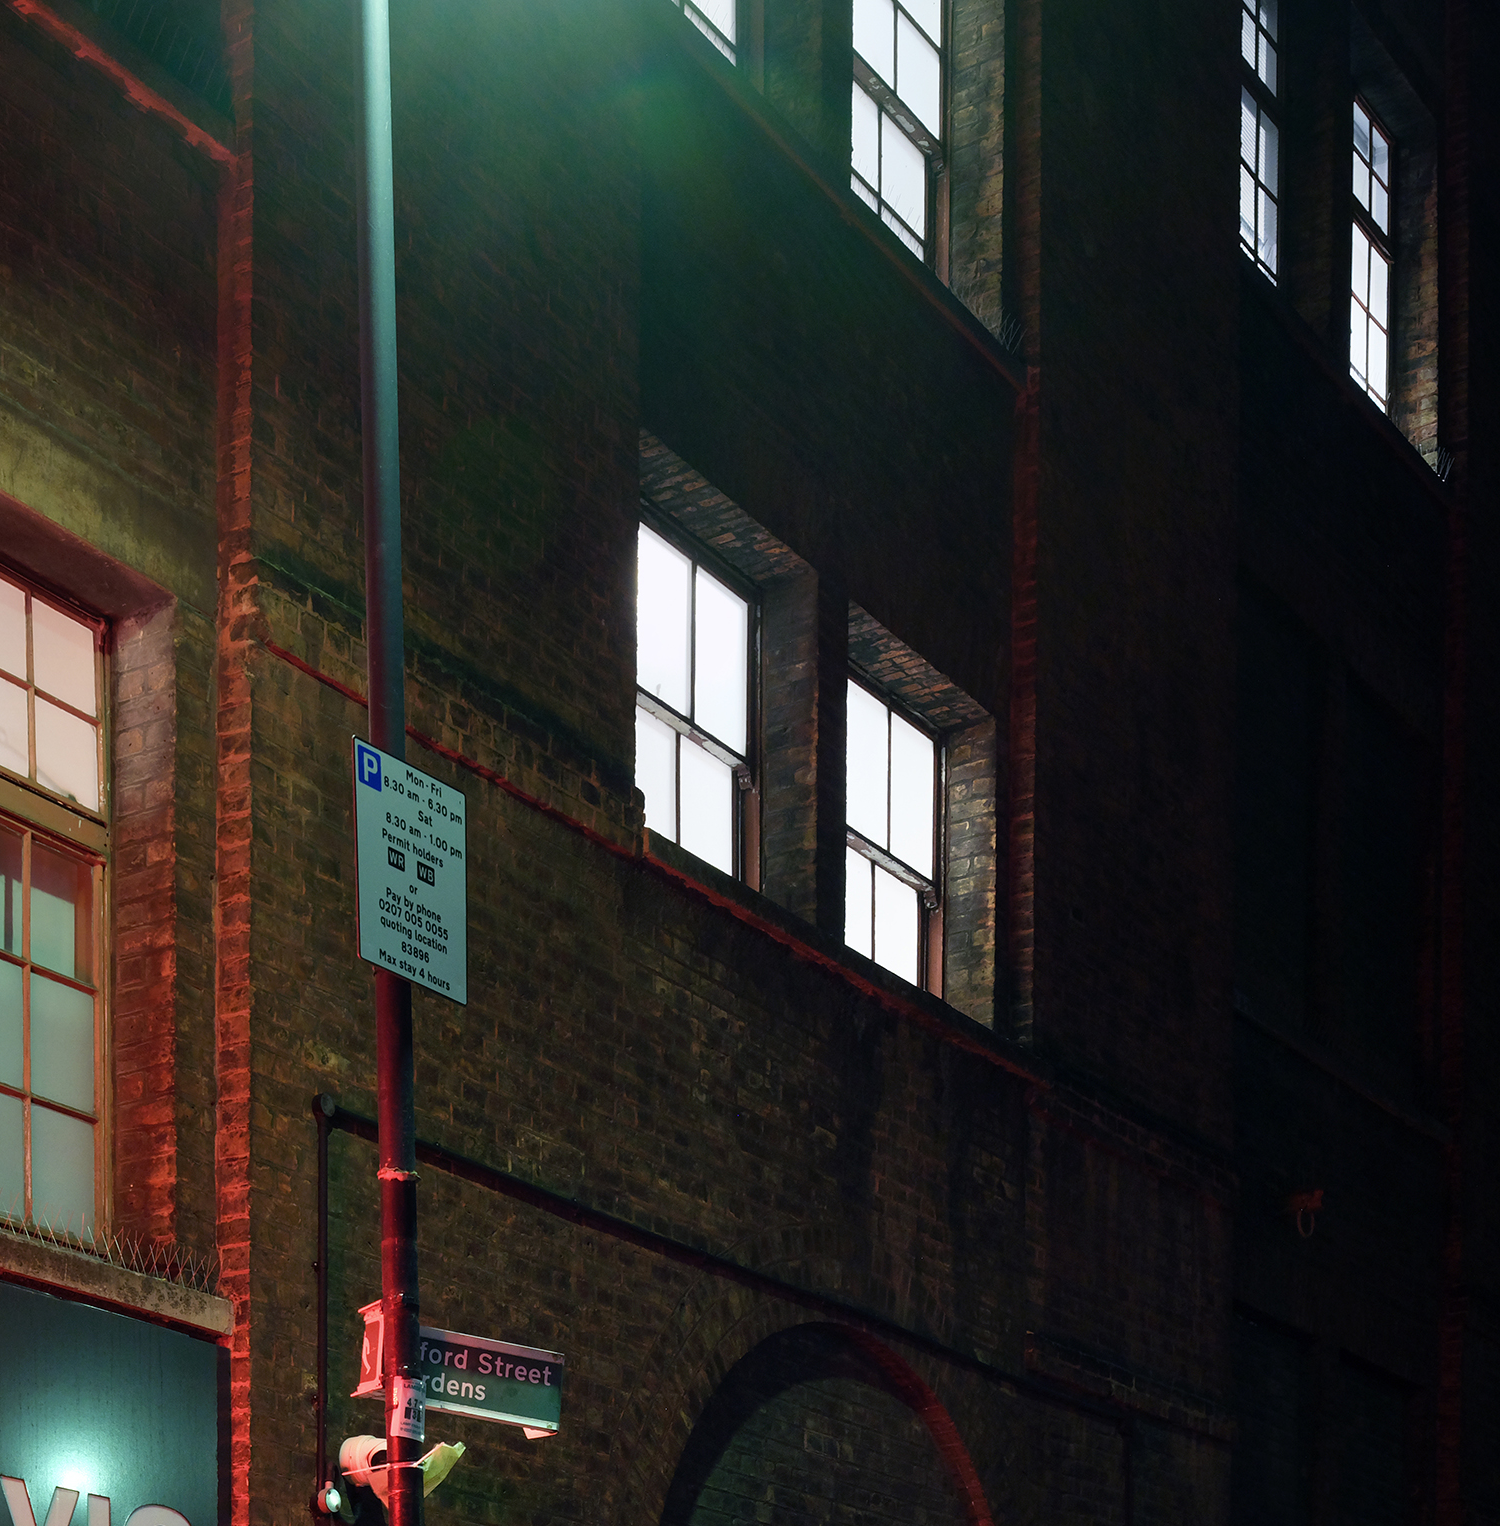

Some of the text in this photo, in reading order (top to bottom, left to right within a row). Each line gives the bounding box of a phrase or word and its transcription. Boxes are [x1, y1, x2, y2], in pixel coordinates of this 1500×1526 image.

[363, 751, 378, 782] P
[383, 775, 405, 795] 8.30
[407, 789, 420, 803] am
[427, 798, 448, 817] 6.30
[450, 812, 463, 825] pm
[417, 810, 433, 827] Sat
[381, 827, 444, 868] Permit holders
[385, 811, 406, 831] 8.30
[408, 825, 421, 839] am
[429, 834, 448, 852] 1.00
[450, 846, 463, 860] pm
[388, 848, 434, 883] WR WB
[386, 886, 442, 924] Pay by phone
[409, 884, 418, 895] or
[378, 898, 449, 940] 0207 005 0055
[380, 916, 448, 954] quoting location
[379, 948, 451, 991] Max stay 4 hours
[401, 941, 430, 964] 83896
[420, 1341, 552, 1387] ford Street
[422, 1373, 486, 1401] rdens
